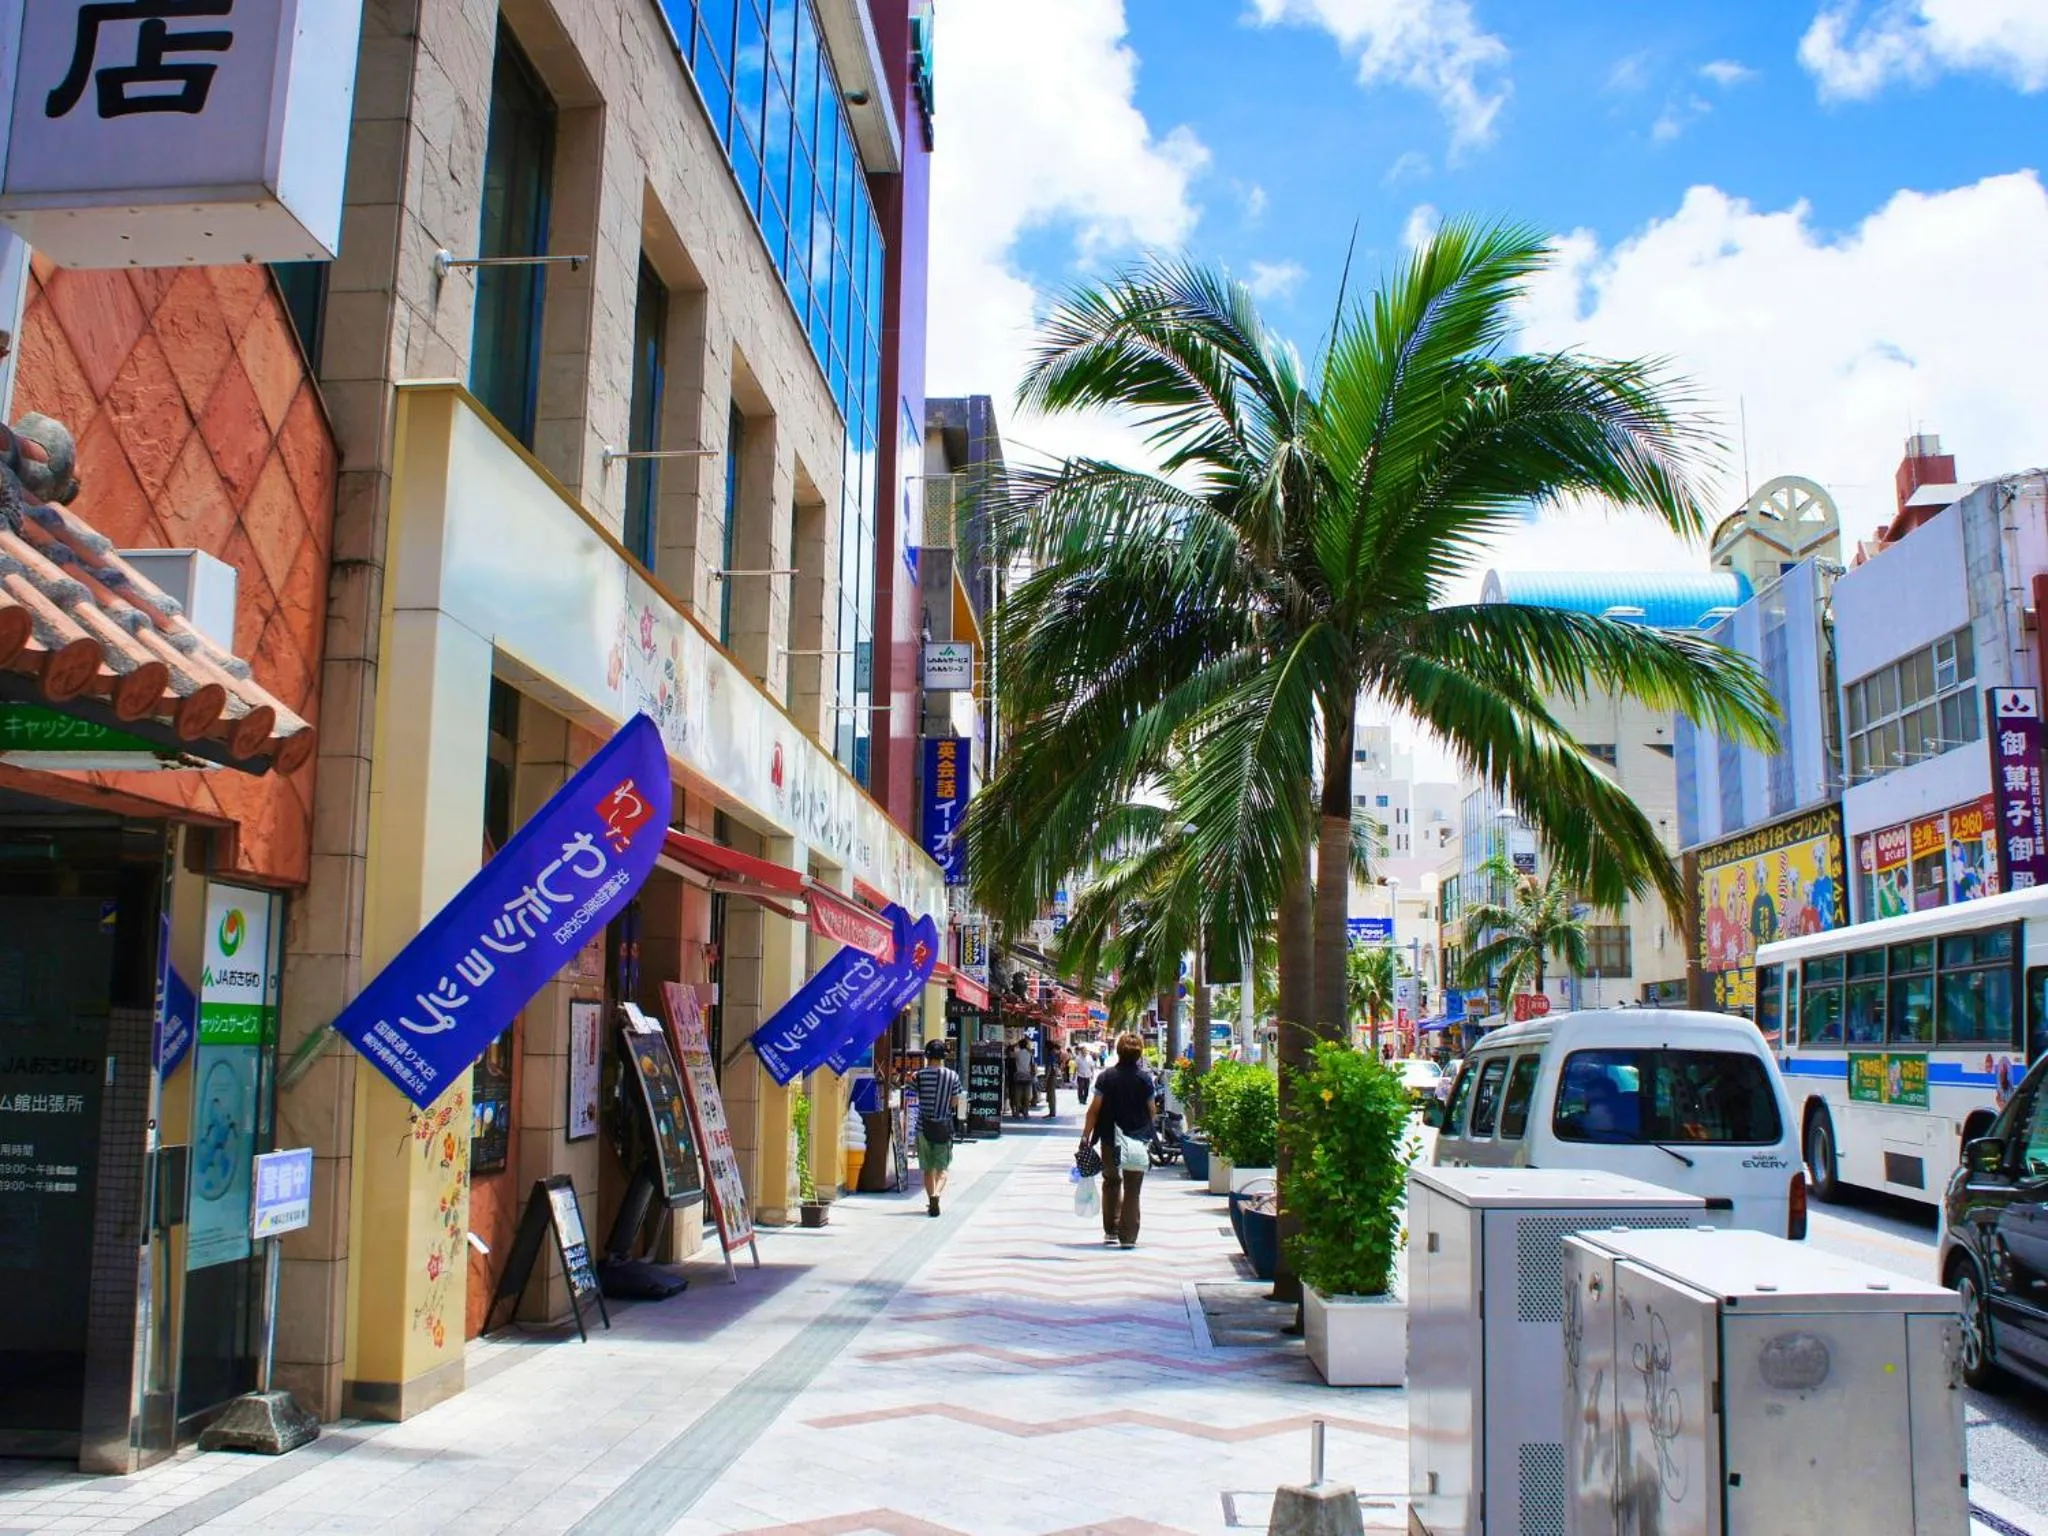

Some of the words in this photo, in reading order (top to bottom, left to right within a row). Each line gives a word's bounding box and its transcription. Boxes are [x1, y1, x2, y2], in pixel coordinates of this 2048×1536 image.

[937, 741, 956, 799] 英会話
[604, 779, 645, 854] わした
[399, 830, 608, 1035] わしたショップ
[774, 956, 876, 1053] わしたショップ
[373, 1020, 438, 1082] 国際通り本店
[971, 1064, 1000, 1076] SILVER
[1742, 1160, 1788, 1169] EVERY
